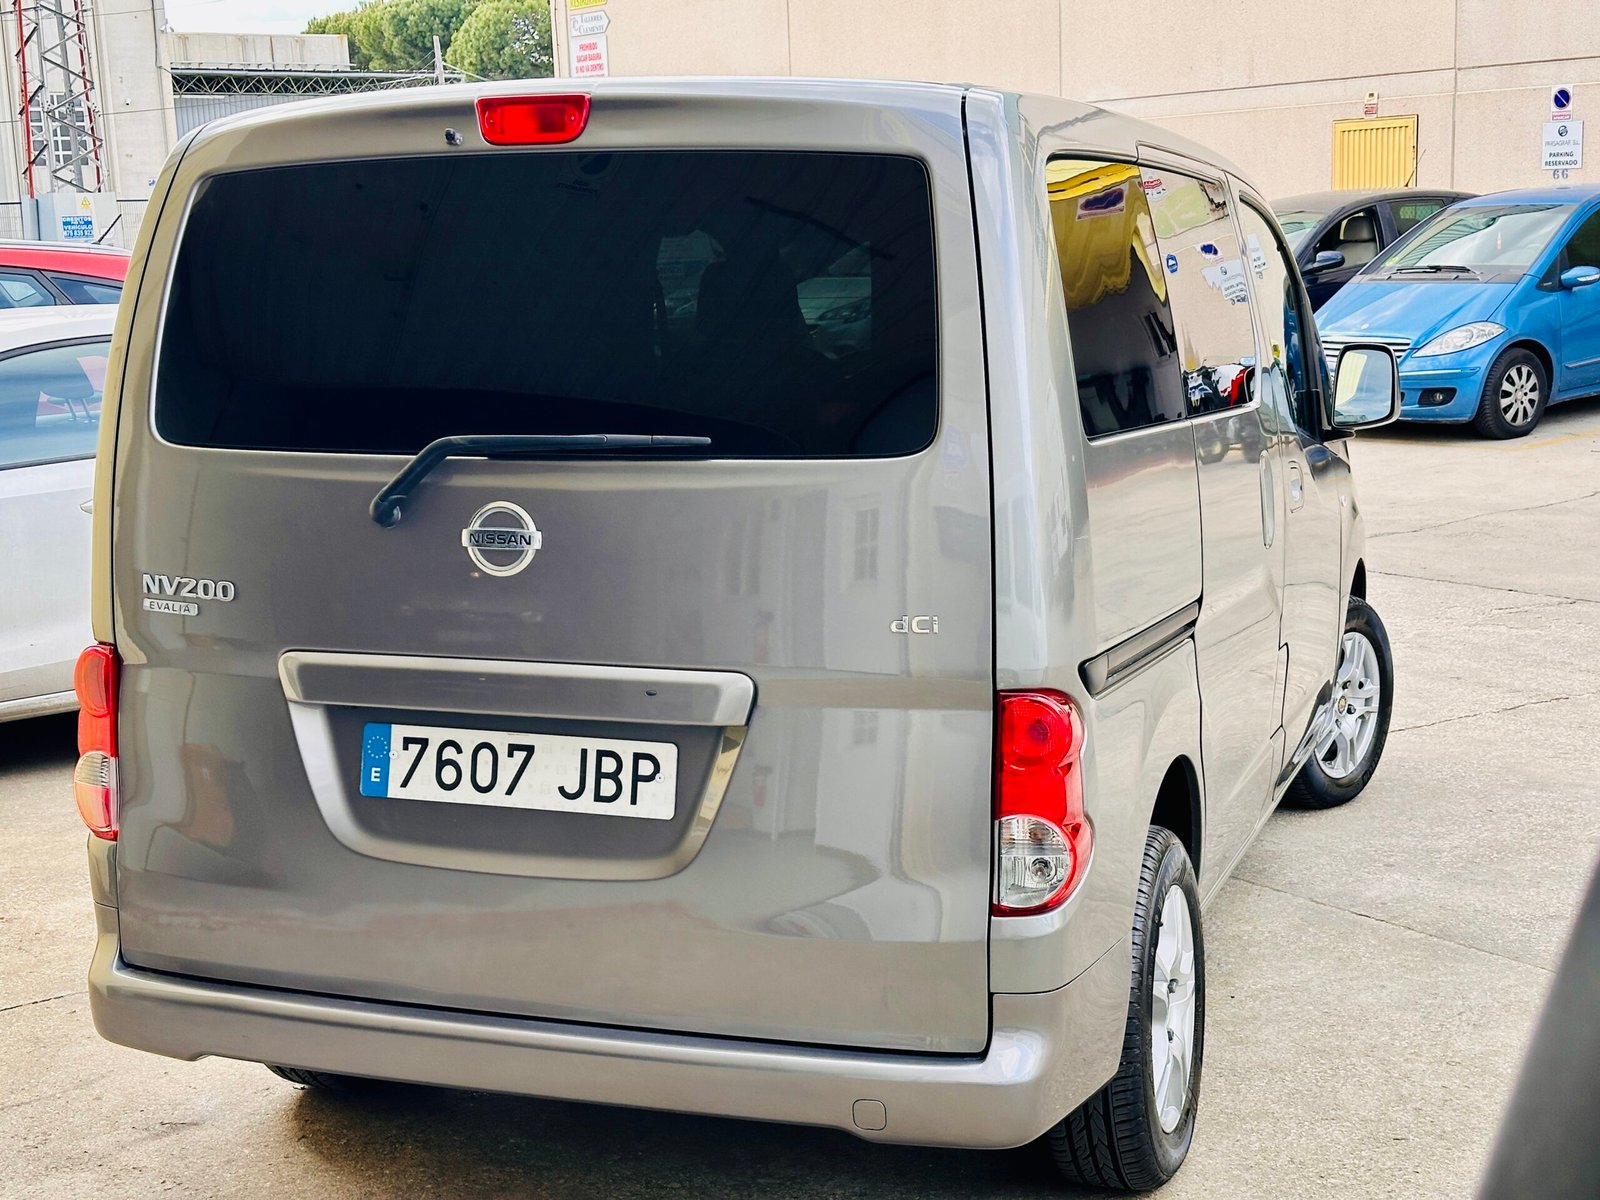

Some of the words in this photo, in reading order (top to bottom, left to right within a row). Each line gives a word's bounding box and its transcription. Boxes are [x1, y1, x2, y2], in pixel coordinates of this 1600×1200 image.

[1548, 150, 1574, 158] PARKING
[1544, 159, 1578, 167] RESERVADO
[469, 533, 532, 546] NISSAN
[142, 573, 235, 602] NV200
[149, 601, 191, 613] EVALIA
[889, 615, 939, 633] dCi
[371, 767, 380, 782] E
[399, 736, 536, 796] 7607
[557, 748, 662, 806] JBP
